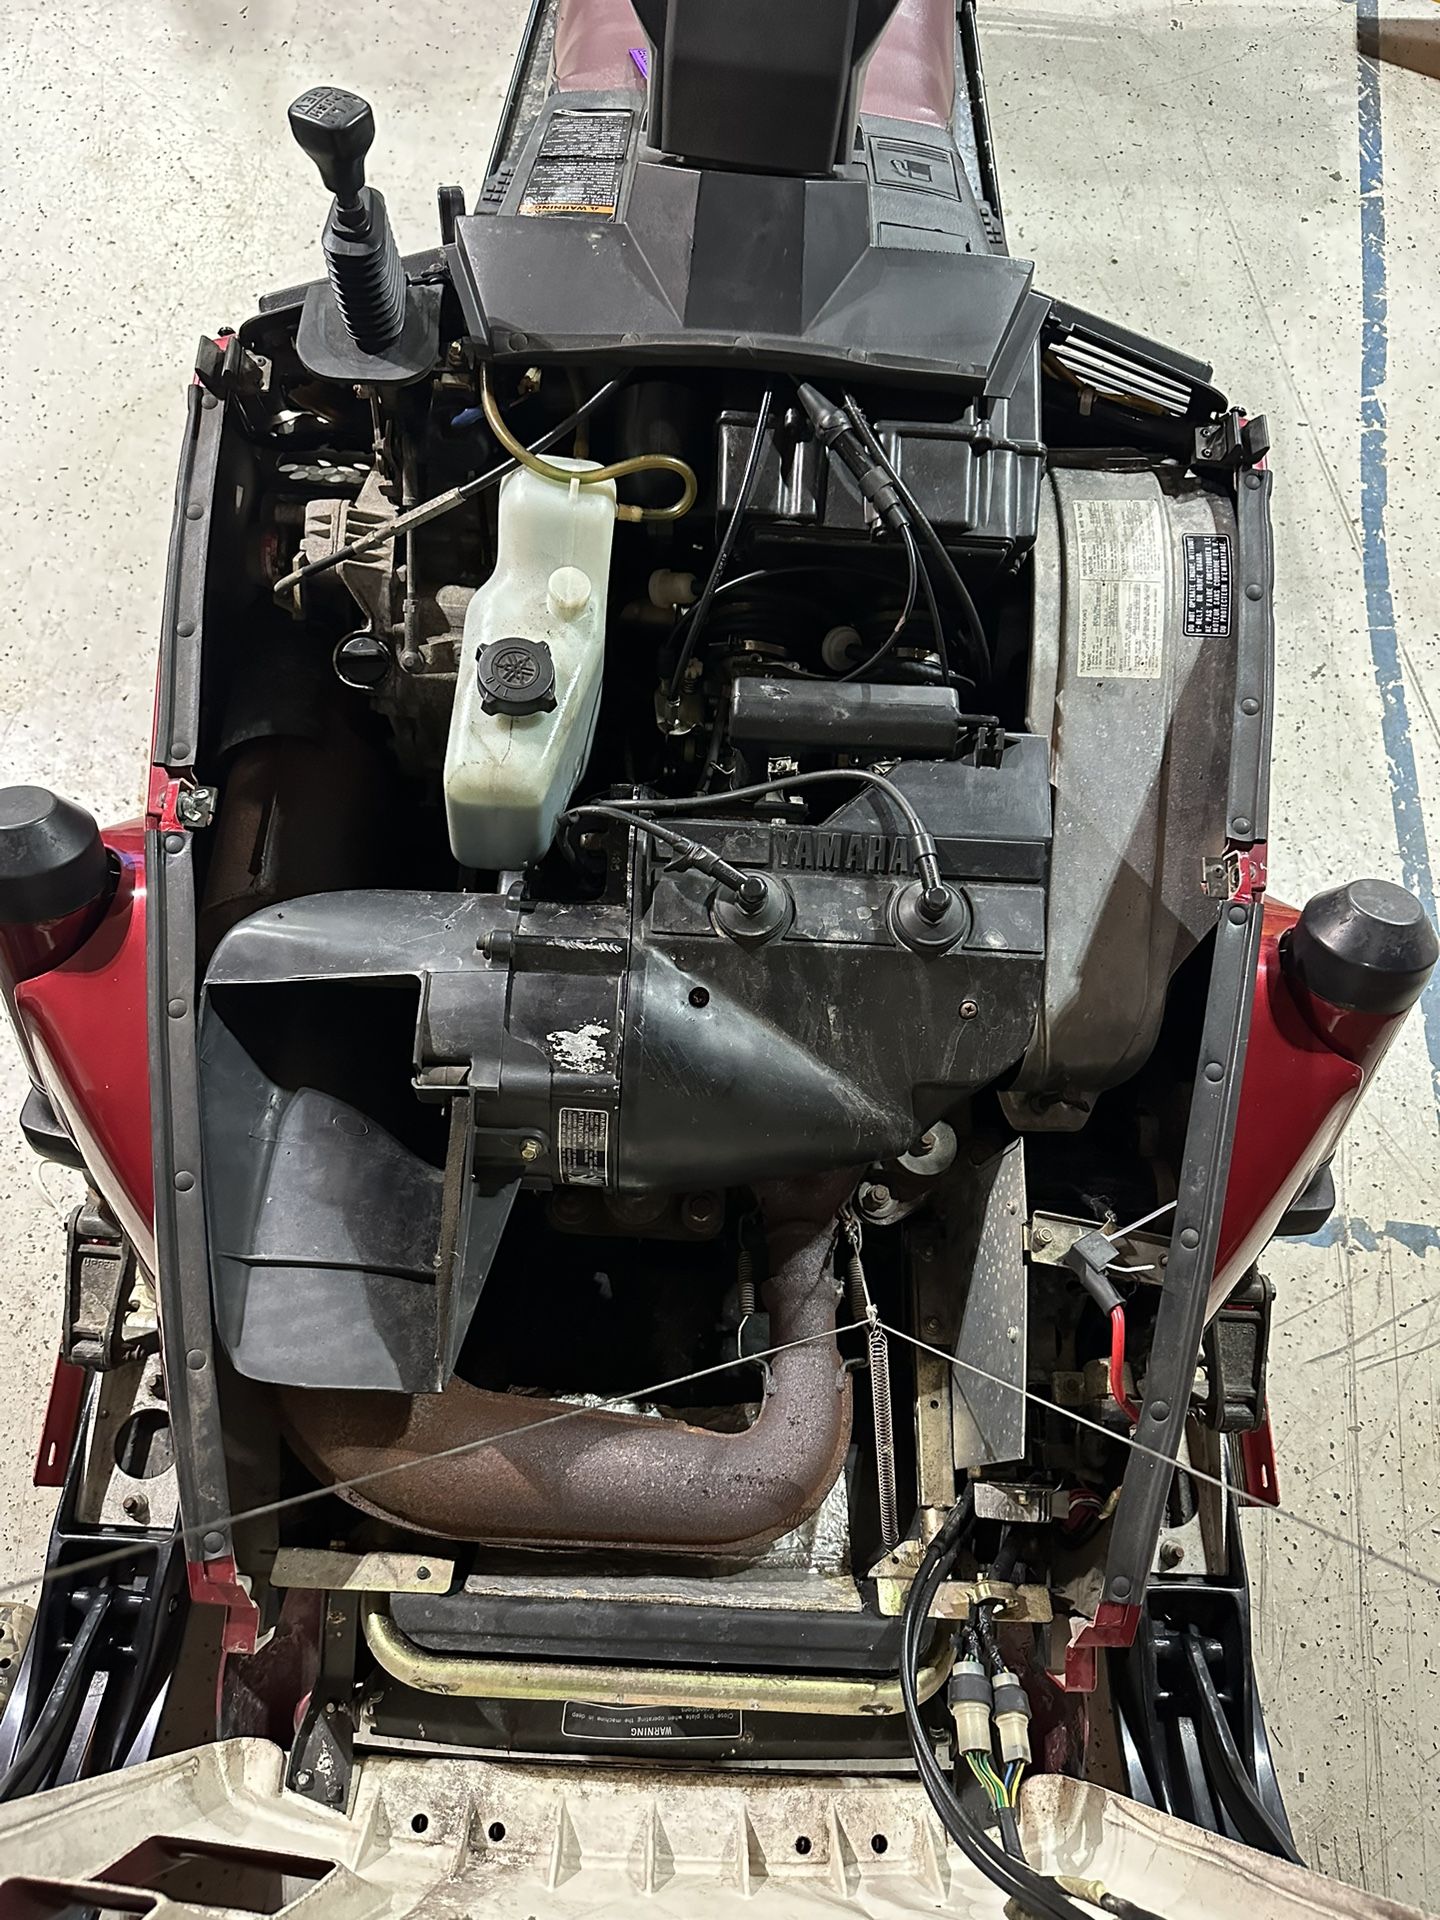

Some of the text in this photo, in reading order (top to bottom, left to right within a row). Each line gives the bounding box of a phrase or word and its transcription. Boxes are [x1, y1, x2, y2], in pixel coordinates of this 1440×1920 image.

[296, 92, 324, 111] REV
[1187, 537, 1195, 560] WITHOUT
[773, 830, 908, 872] YAMAHA
[571, 1712, 586, 1720] deep
[637, 1715, 664, 1723] operating
[631, 1726, 672, 1736] WARNING
